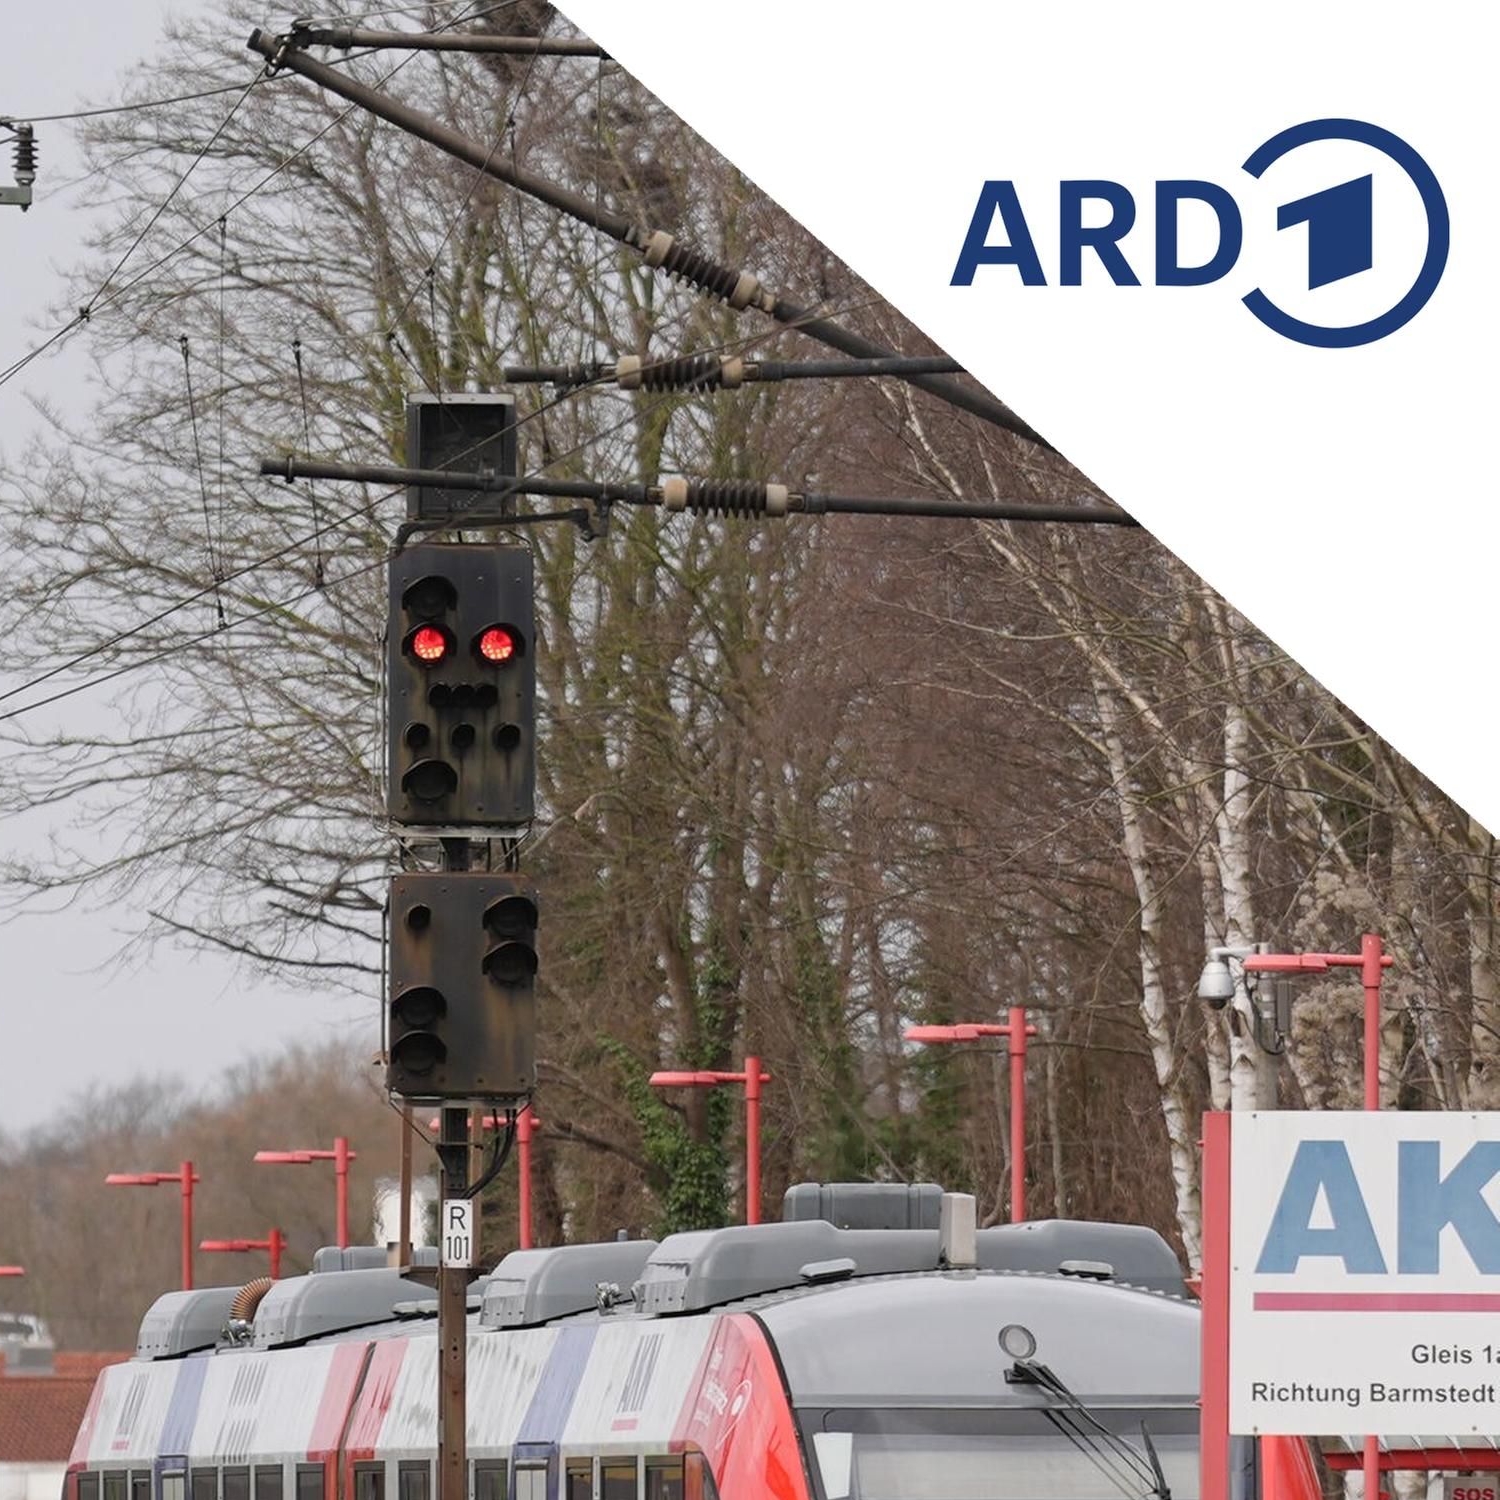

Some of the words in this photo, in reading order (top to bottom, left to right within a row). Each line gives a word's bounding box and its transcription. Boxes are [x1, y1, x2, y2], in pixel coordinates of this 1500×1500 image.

[450, 1206, 466, 1230] R
[446, 1235, 469, 1260] 101
[1411, 1344, 1473, 1364] Gleis
[1251, 1382, 1361, 1407] Richtung
[1370, 1382, 1495, 1403] Barmstedt
